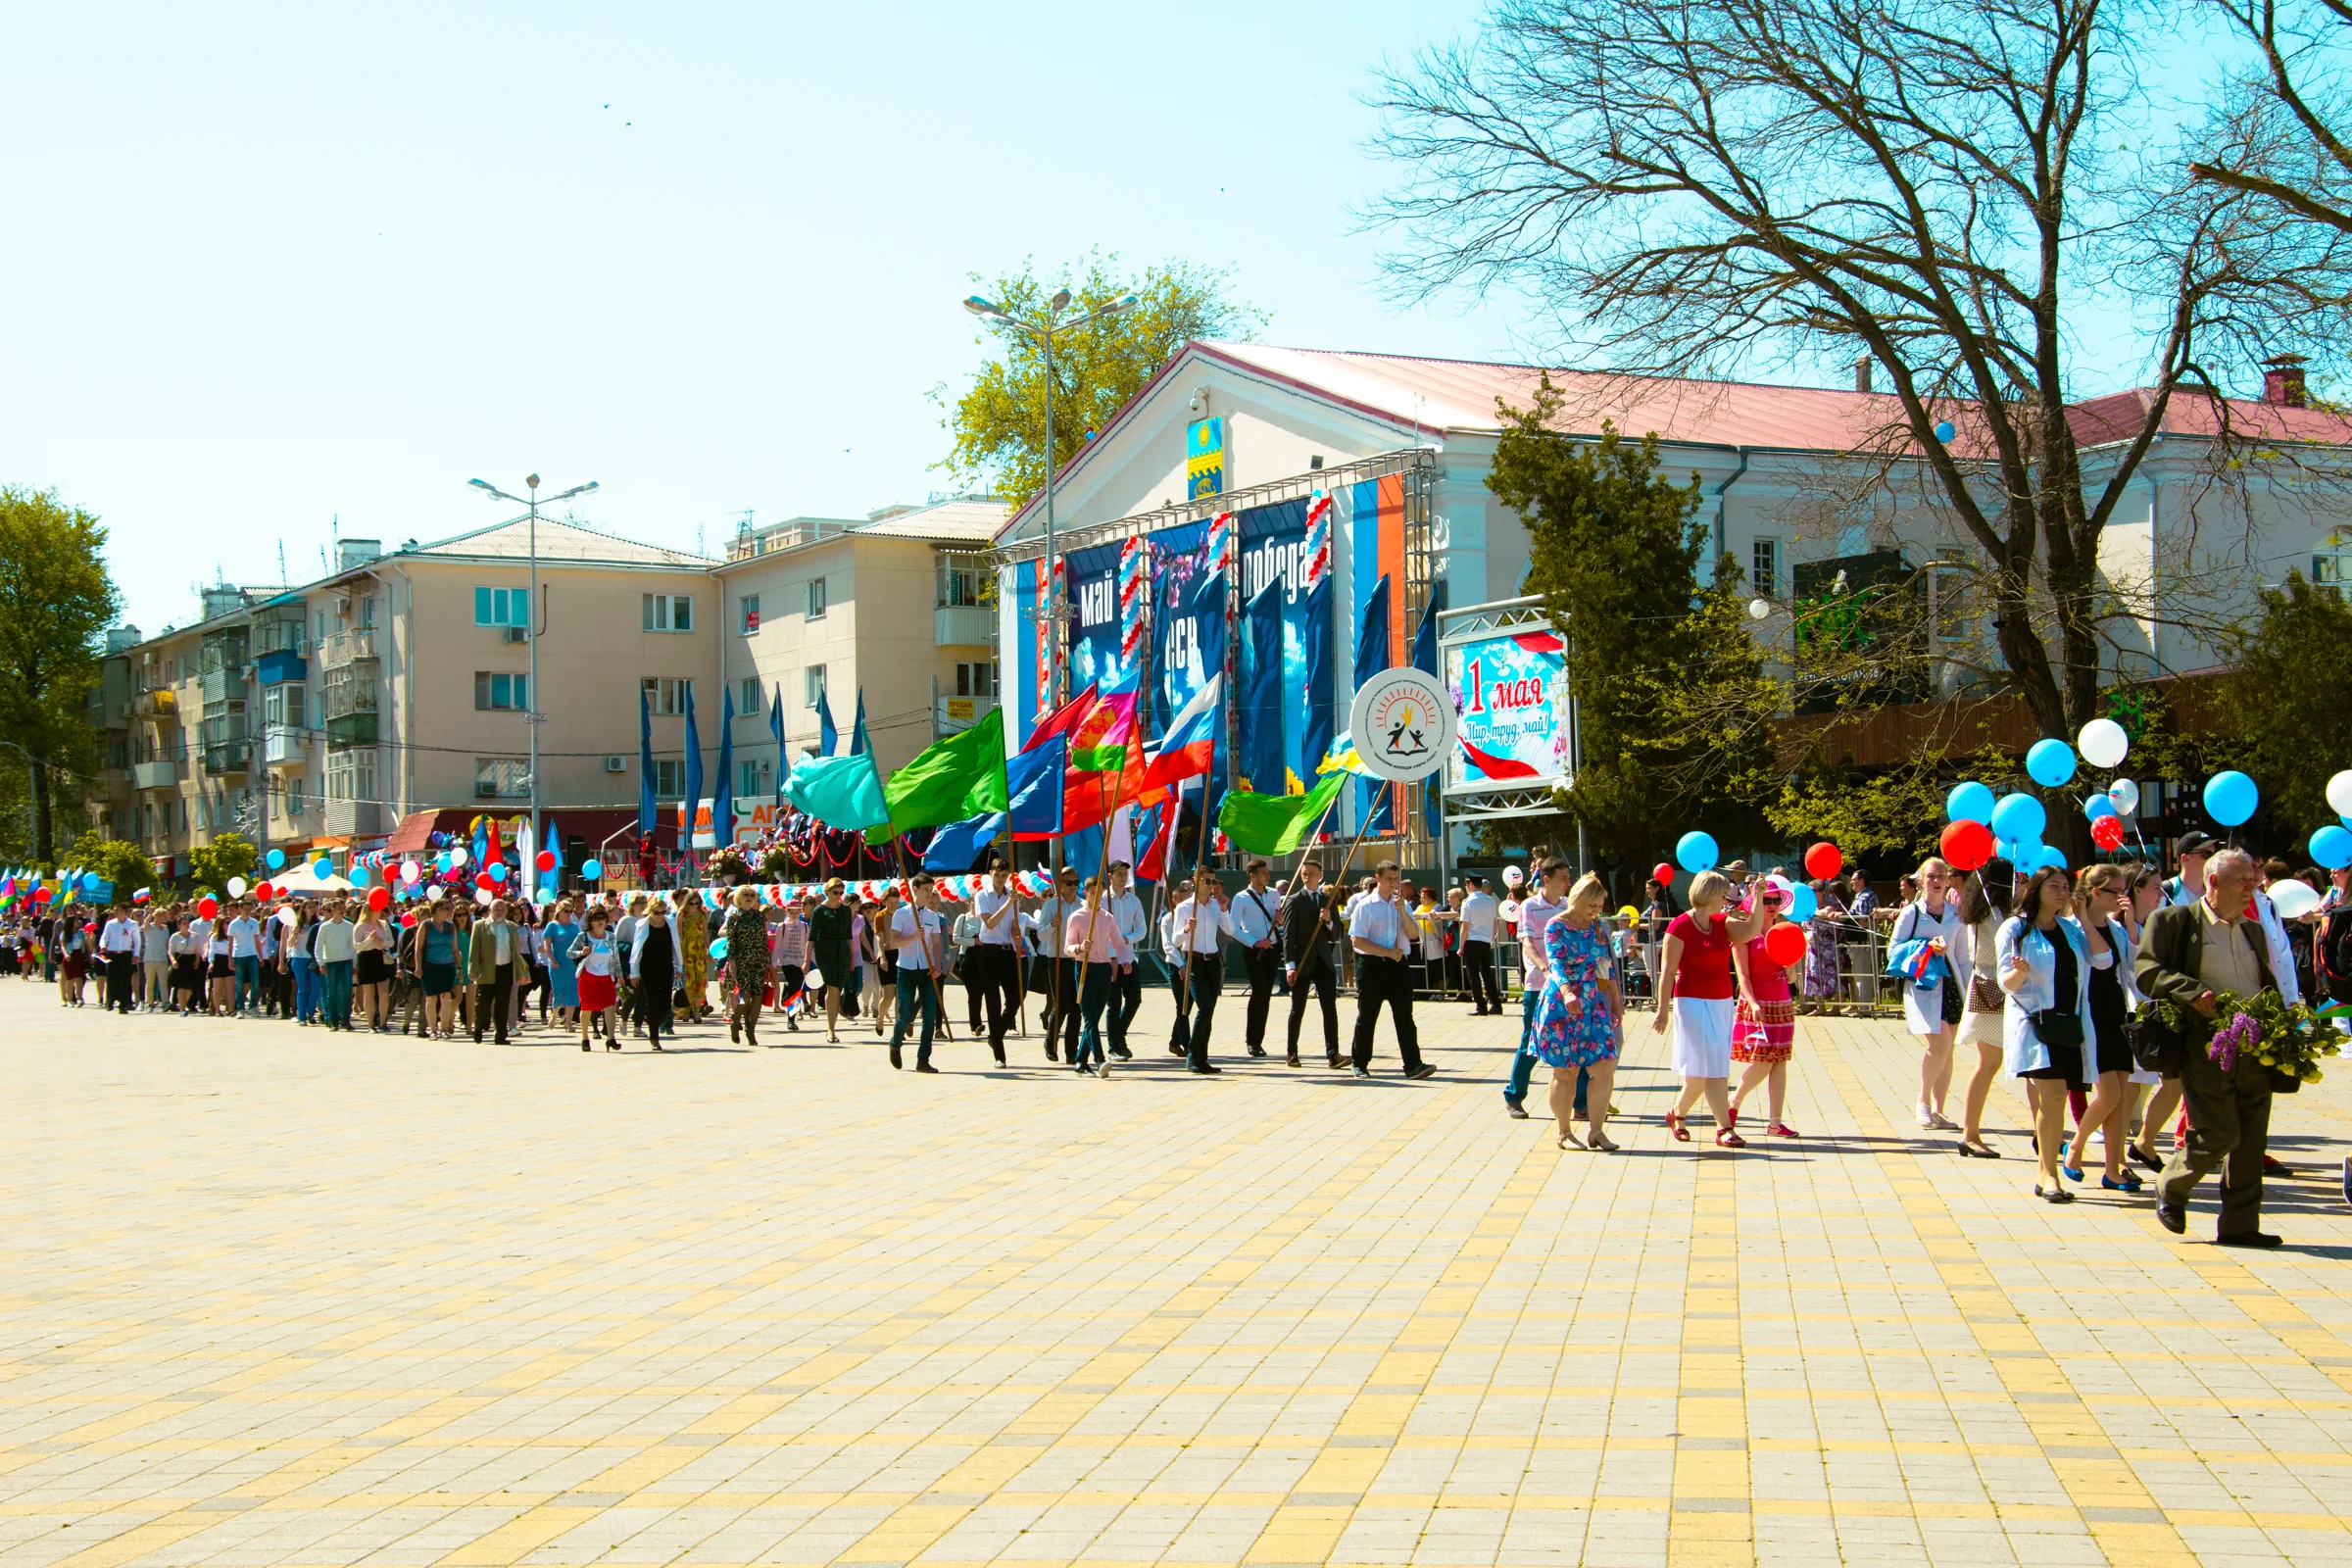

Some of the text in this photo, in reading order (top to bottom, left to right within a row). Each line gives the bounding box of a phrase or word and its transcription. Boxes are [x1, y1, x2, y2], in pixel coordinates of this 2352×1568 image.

[1081, 569, 1113, 627] май
[1470, 659, 1545, 712] 1 мая
[1492, 723, 1520, 745] труд,
[1522, 714, 1548, 735] май!
